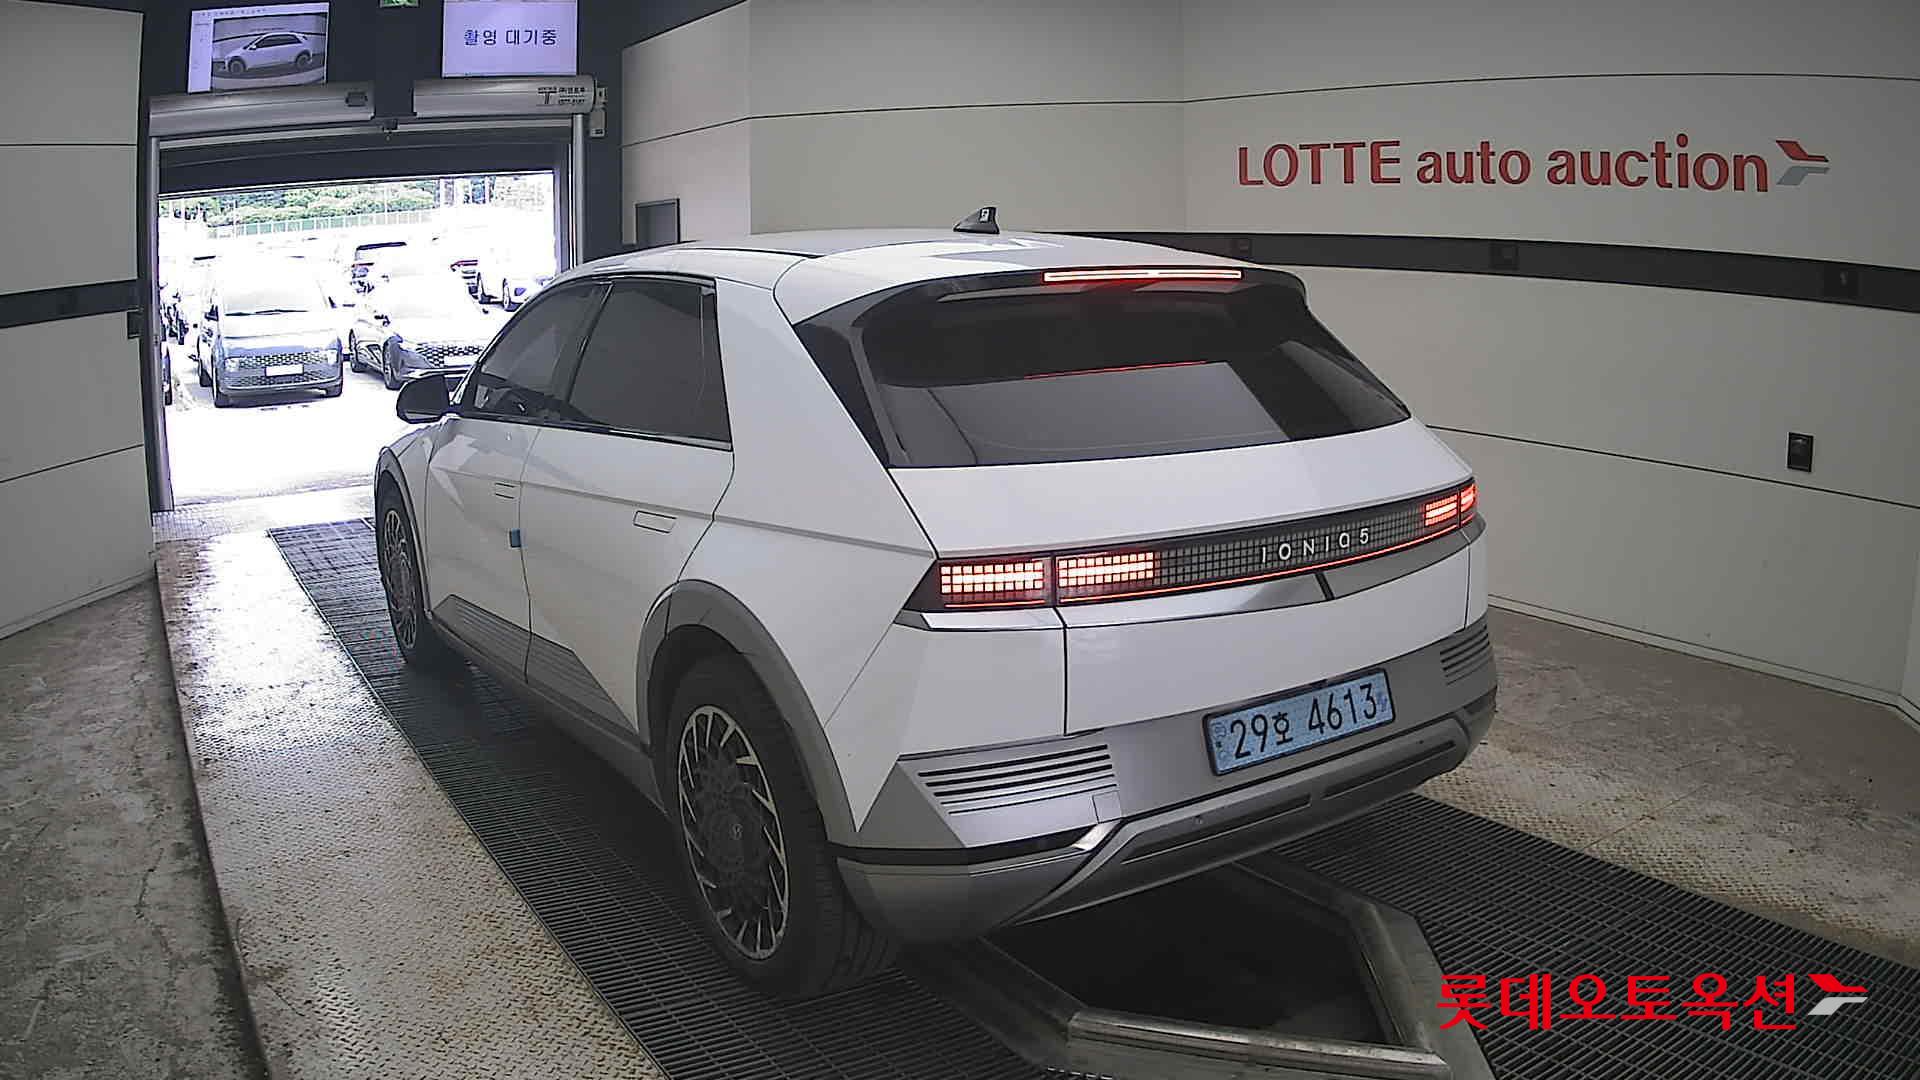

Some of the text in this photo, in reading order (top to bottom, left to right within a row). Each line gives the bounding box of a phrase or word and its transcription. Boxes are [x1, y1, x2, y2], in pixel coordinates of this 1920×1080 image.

[464, 29, 558, 46] 촬영 대기중
[1238, 133, 1768, 193] LOTTE auto auction
[1261, 528, 1370, 563] IONIQ 5
[1229, 682, 1378, 760] 29호 4613
